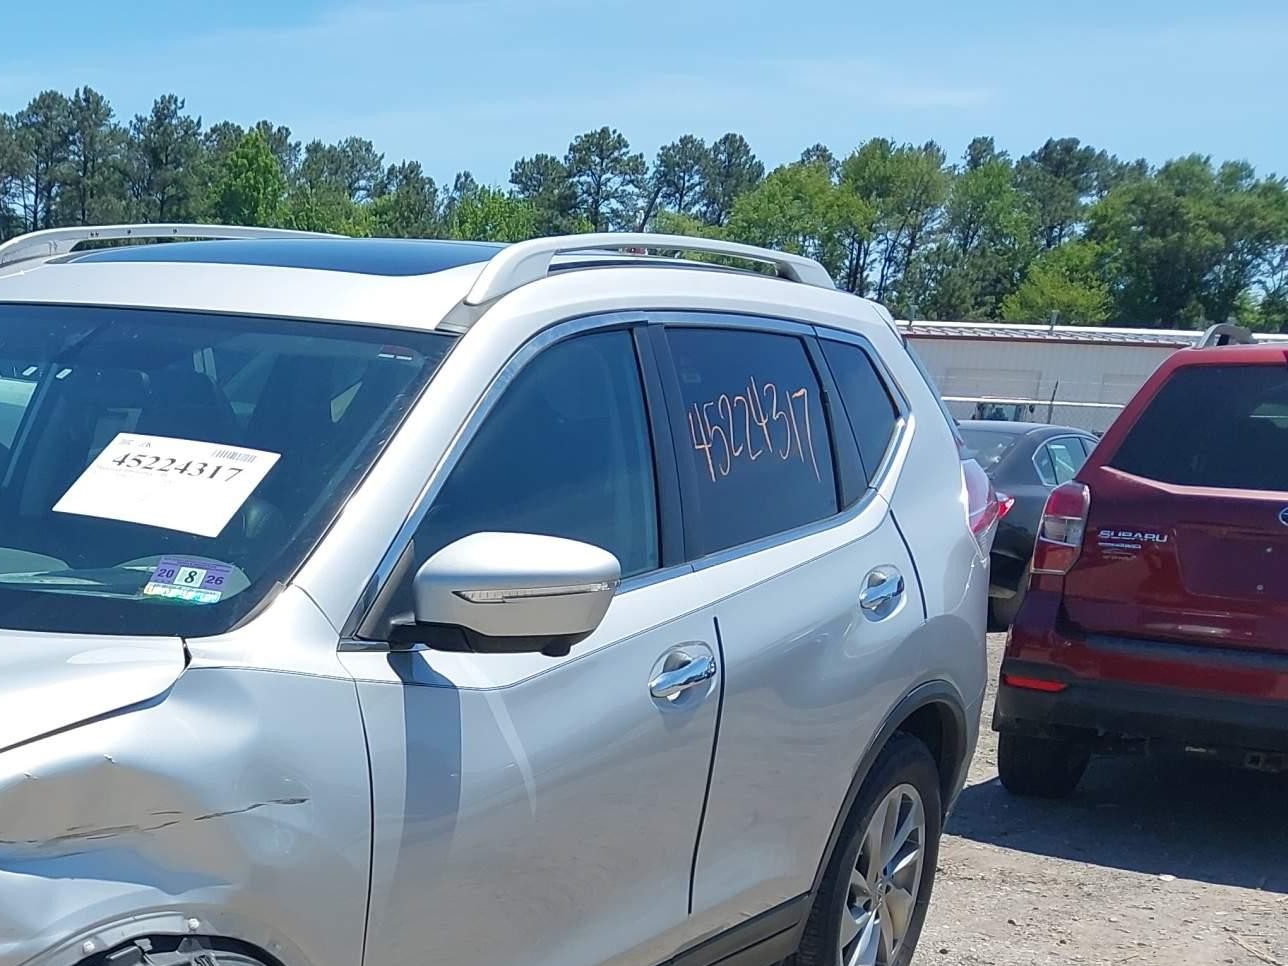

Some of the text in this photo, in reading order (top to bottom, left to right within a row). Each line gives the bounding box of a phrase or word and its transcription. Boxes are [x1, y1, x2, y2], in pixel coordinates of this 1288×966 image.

[688, 375, 821, 483] 45224317
[111, 452, 243, 482] 45224317
[1097, 529, 1169, 543] SUBARU
[157, 568, 225, 586] 20 8 26
